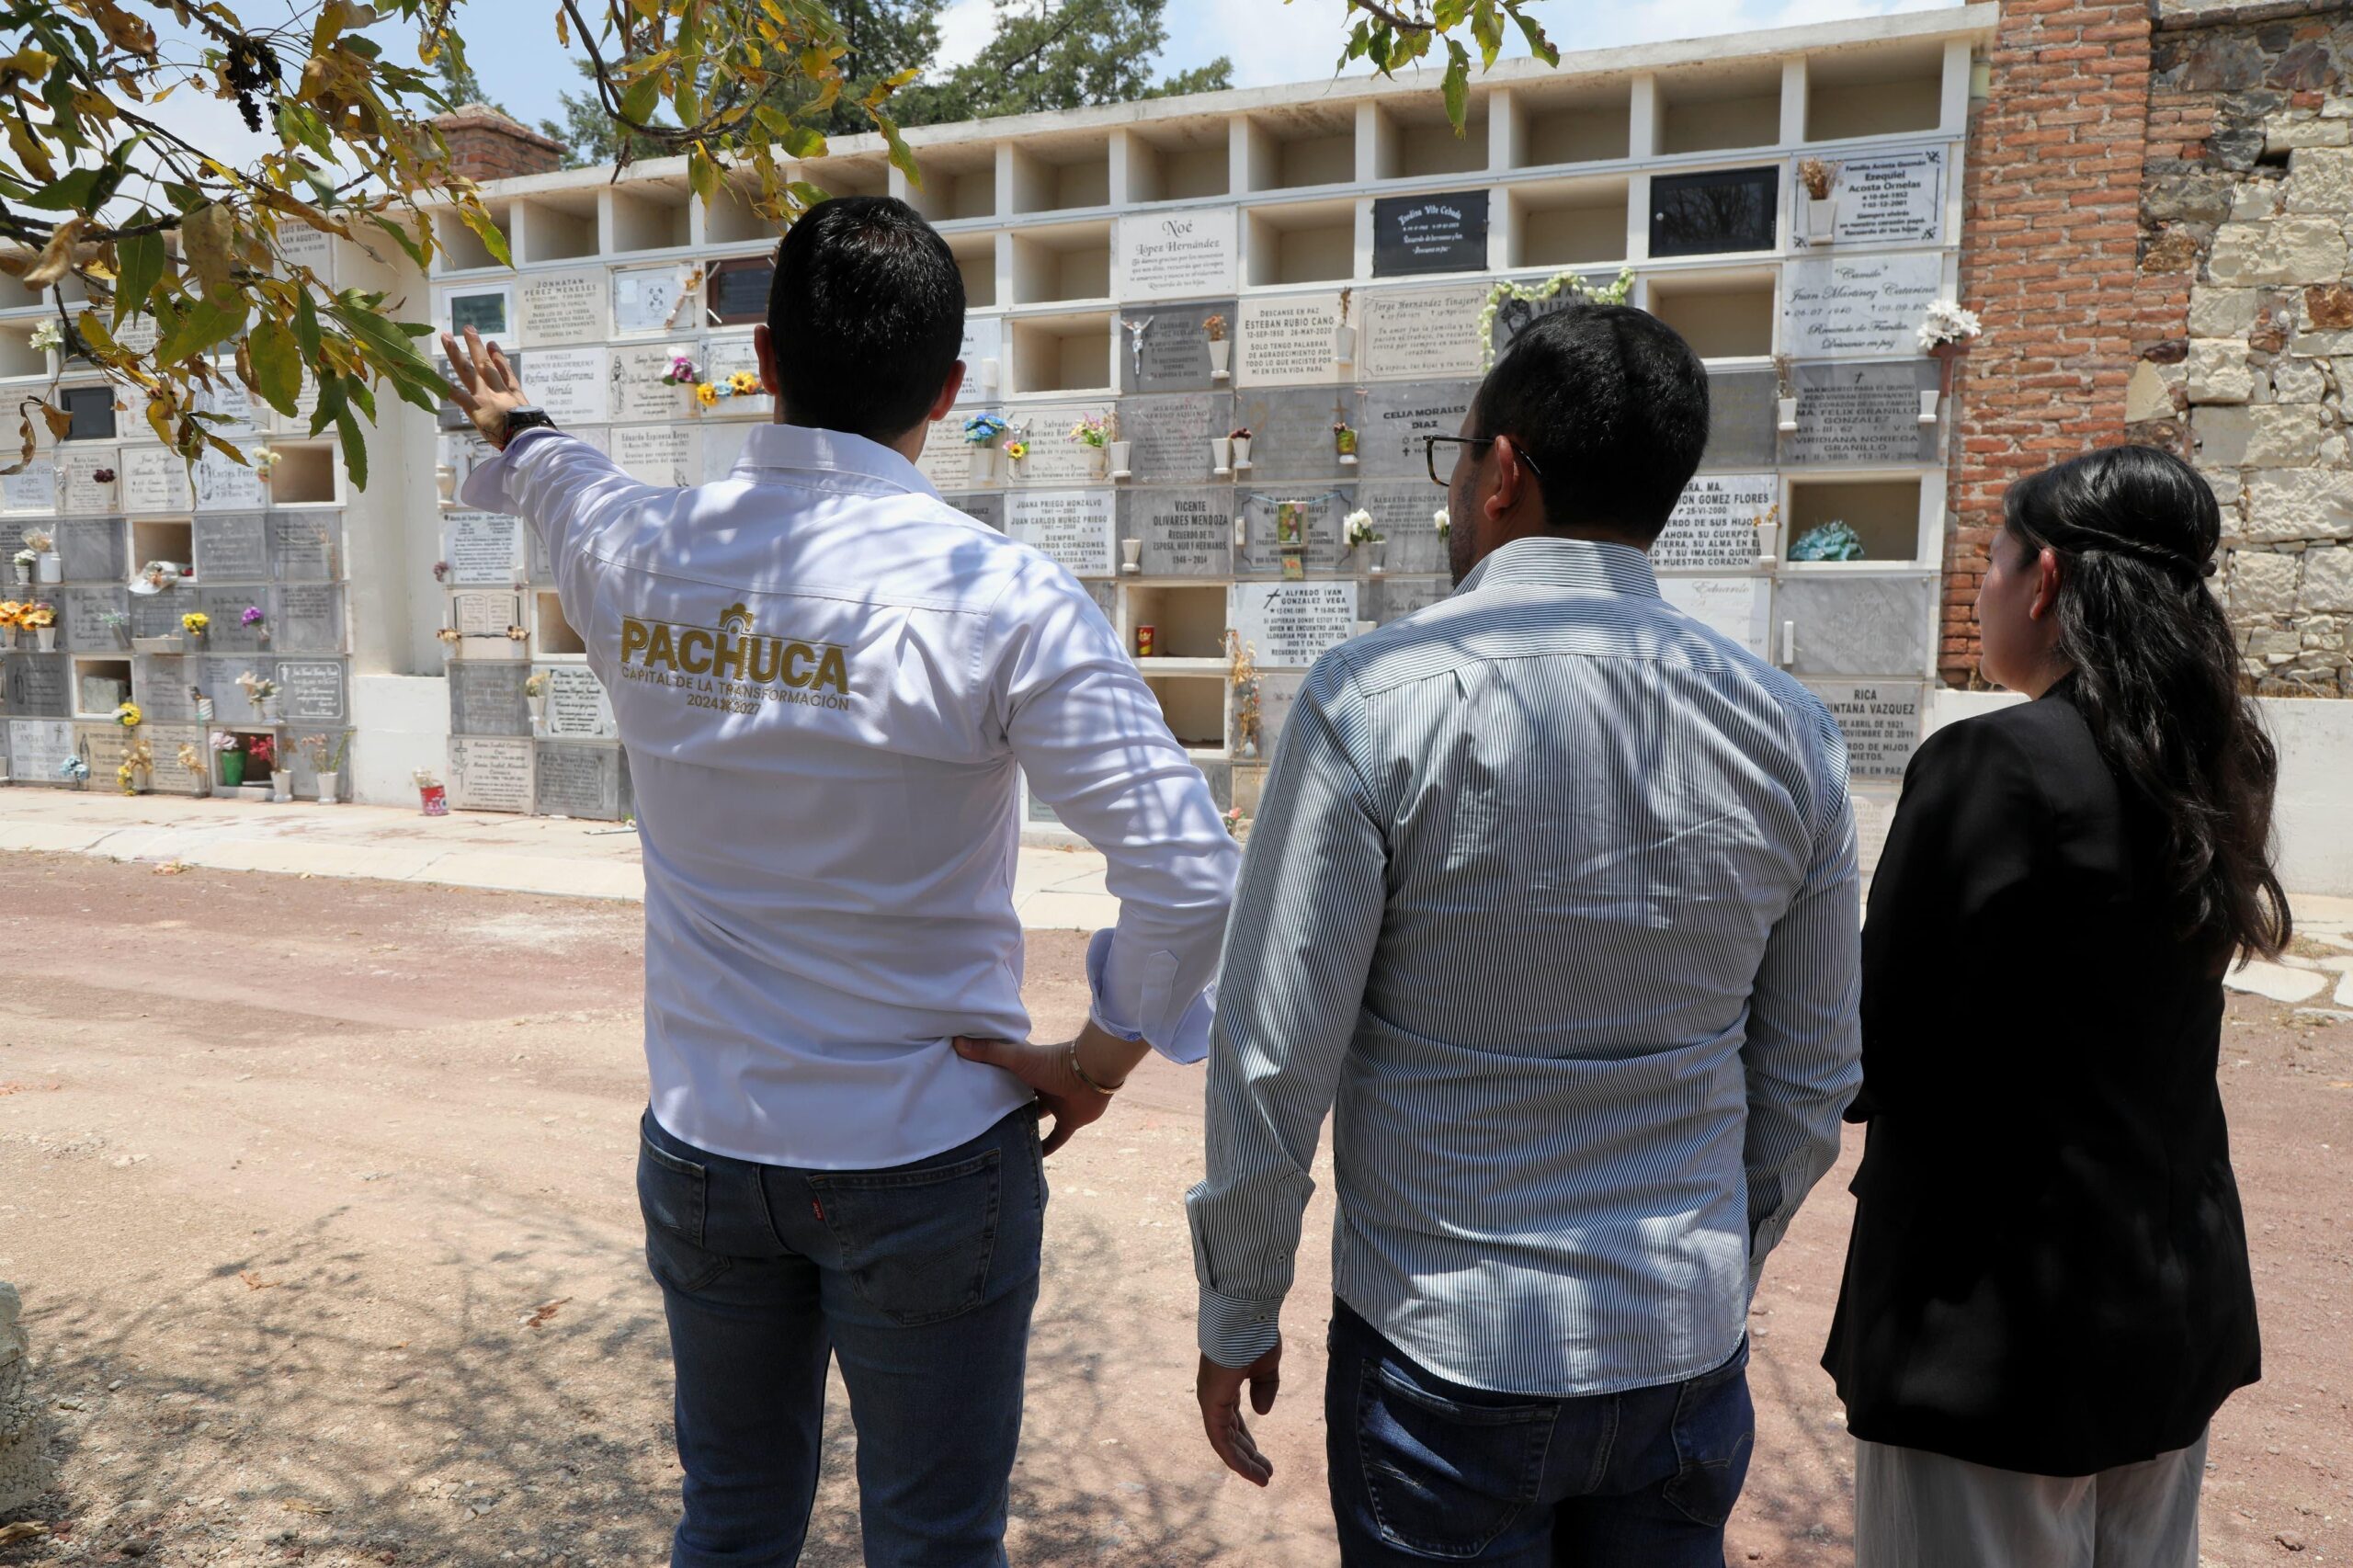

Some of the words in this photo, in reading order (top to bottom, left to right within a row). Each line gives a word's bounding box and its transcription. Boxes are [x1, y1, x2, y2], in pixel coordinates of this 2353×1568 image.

[1865, 170, 1905, 181] Ezequiel
[1849, 184, 1881, 192] Acosta
[1884, 181, 1921, 190] Ornelas
[1162, 220, 1193, 238] Noé
[1136, 244, 1164, 256] López
[1165, 238, 1220, 252] Hernández
[537, 279, 584, 289] JONHATAN
[556, 284, 597, 293] MENESES
[1786, 288, 1818, 303] Juan
[1373, 302, 1395, 312] Jorge
[1260, 309, 1294, 317] DESCANSE
[1245, 319, 1281, 330] ESTEBAN
[1284, 318, 1308, 326] RUBIO
[1312, 316, 1334, 325] CANO
[1259, 349, 1315, 358] AGRADECIMIENTO
[1383, 411, 1414, 419] CELIA
[1415, 405, 1467, 416] MORALES
[1707, 483, 1723, 492] MA.
[1699, 494, 1730, 504] GOMEZ
[1734, 494, 1768, 504] FLORES
[1175, 500, 1206, 511] VICENTE
[1154, 515, 1188, 526] OLIVARES
[1191, 515, 1228, 526] MENDOZA
[1711, 518, 1727, 527] SUS
[1168, 529, 1198, 540] RECUERDO
[1665, 530, 1693, 539] AHORA
[1729, 548, 1761, 556] QUERID
[1665, 558, 1704, 566] NUESTRO
[621, 619, 849, 695] PACHUCA
[621, 666, 671, 687] CAPITAL
[676, 676, 692, 689] DE
[698, 679, 712, 692] LA
[719, 682, 849, 711] TRANSFORMACIÓN
[1854, 689, 1877, 700] RICA
[687, 694, 718, 710] 2024
[734, 701, 761, 715] 2027
[1870, 704, 1915, 714] VAZQUEZ
